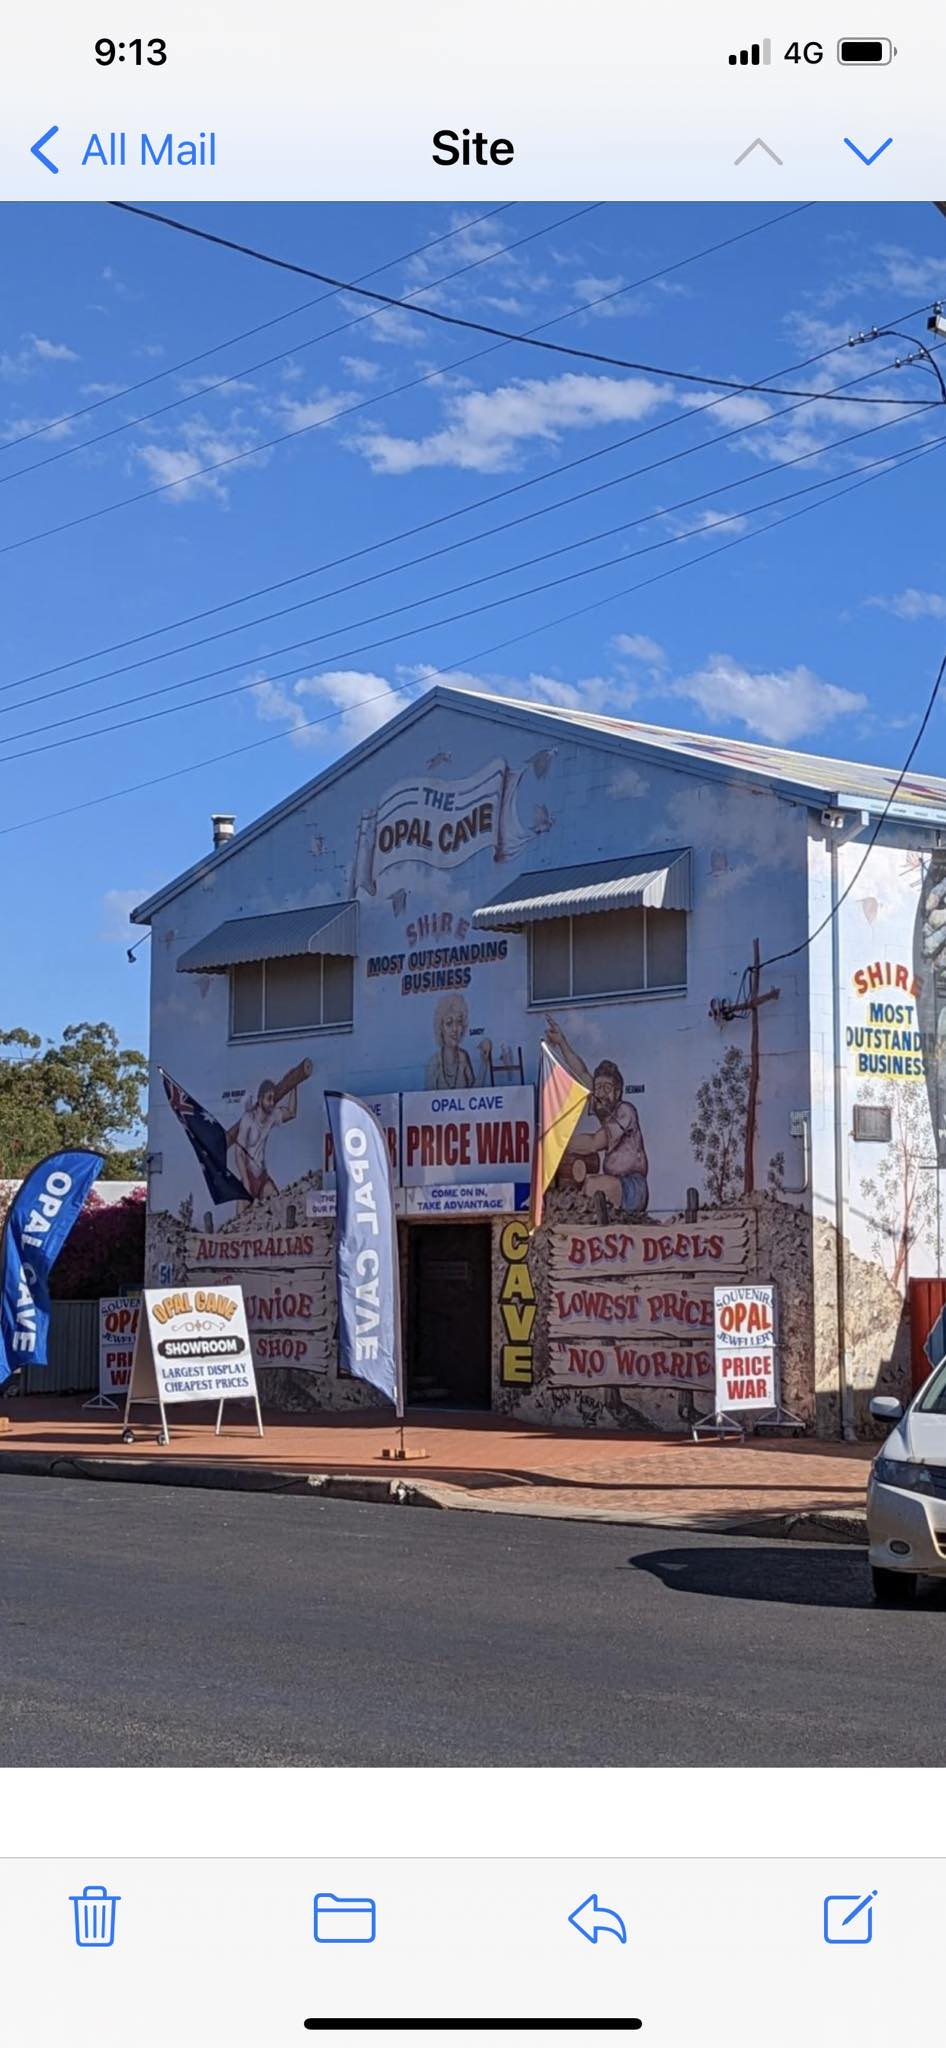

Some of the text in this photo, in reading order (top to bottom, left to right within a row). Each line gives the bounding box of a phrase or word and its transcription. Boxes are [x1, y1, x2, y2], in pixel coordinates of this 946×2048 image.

[423, 787, 456, 811] THE
[379, 803, 493, 853] OPAL CAVE
[405, 911, 471, 947] SHIRE
[367, 940, 508, 977] MOST OUTSTANDING
[401, 967, 472, 995] BUSINESS
[869, 1002, 914, 1024] MOST
[858, 1053, 928, 1076] BUSINESS
[431, 1096, 503, 1112] OPAL CAVE
[407, 1123, 471, 1167] PRICE
[475, 1121, 530, 1164] WAR
[431, 1188, 458, 1199] COME
[461, 1187, 473, 1196] ON
[21, 1171, 72, 1251] OPAL
[417, 1199, 504, 1211] TAKE ADVANTAGE
[568, 1233, 634, 1264] BEST
[102, 1298, 141, 1316] SOUVEN
[152, 1291, 238, 1324] OPAL CAVE
[501, 1220, 536, 1387] CAVE
[555, 1290, 638, 1321] LOWEST
[720, 1302, 772, 1333] OPAL
[165, 1339, 237, 1355] SHOWROOM
[255, 1337, 308, 1360] SHOP
[106, 1352, 134, 1368] PRI
[162, 1364, 247, 1378] LARGEST DISPLAY
[616, 1344, 715, 1378] WORRIE
[722, 1356, 772, 1377] PRICE
[164, 1377, 249, 1393] CHEAPEST PRICES
[727, 1379, 767, 1400] WAR
